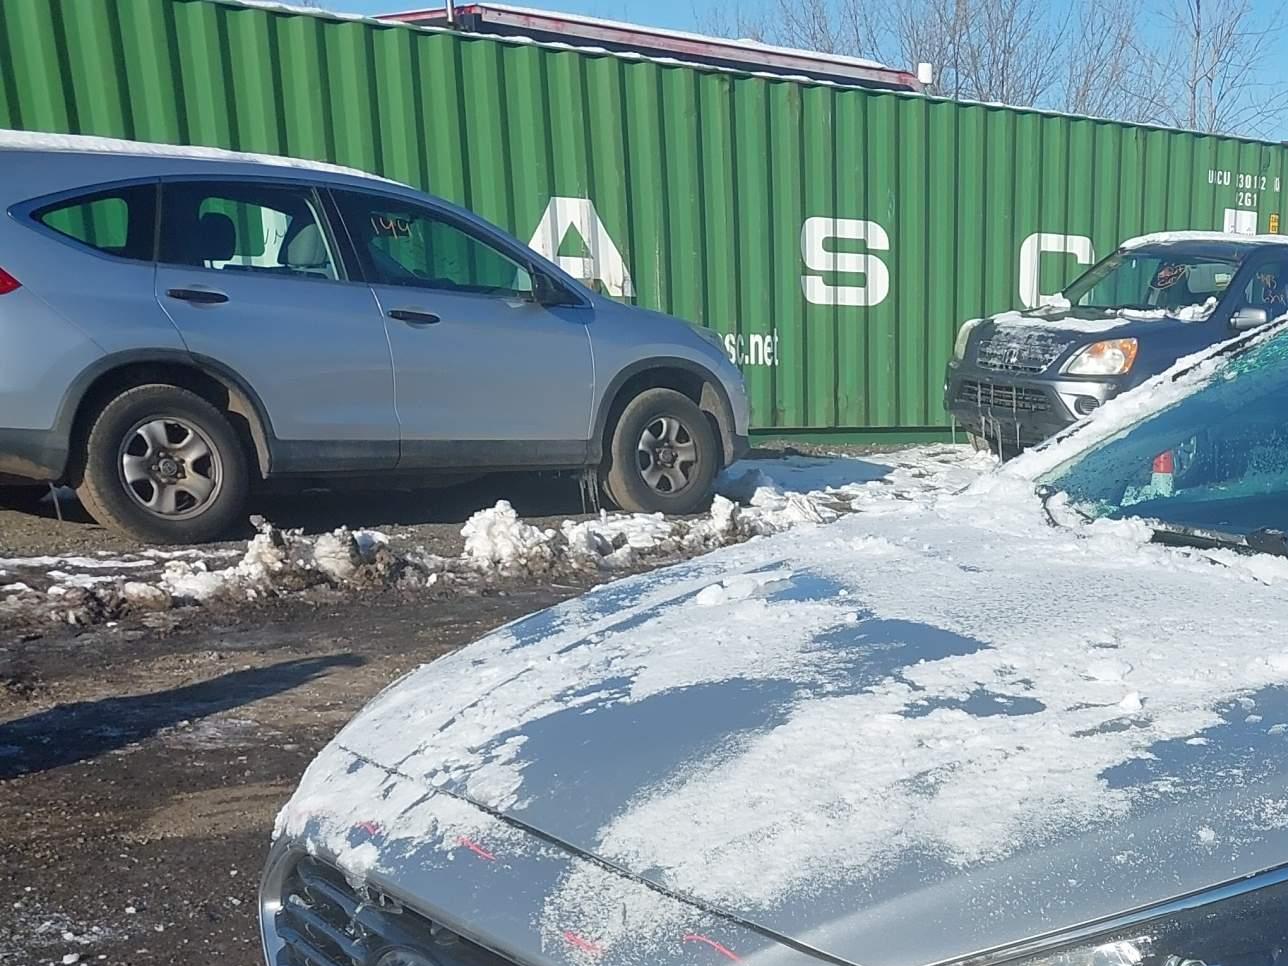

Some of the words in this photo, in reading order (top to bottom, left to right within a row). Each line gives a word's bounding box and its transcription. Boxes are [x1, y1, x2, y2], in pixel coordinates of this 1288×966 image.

[528, 196, 637, 297] A
[800, 216, 890, 307] S
[1017, 232, 1095, 308] C
[717, 327, 779, 367] sc.net
